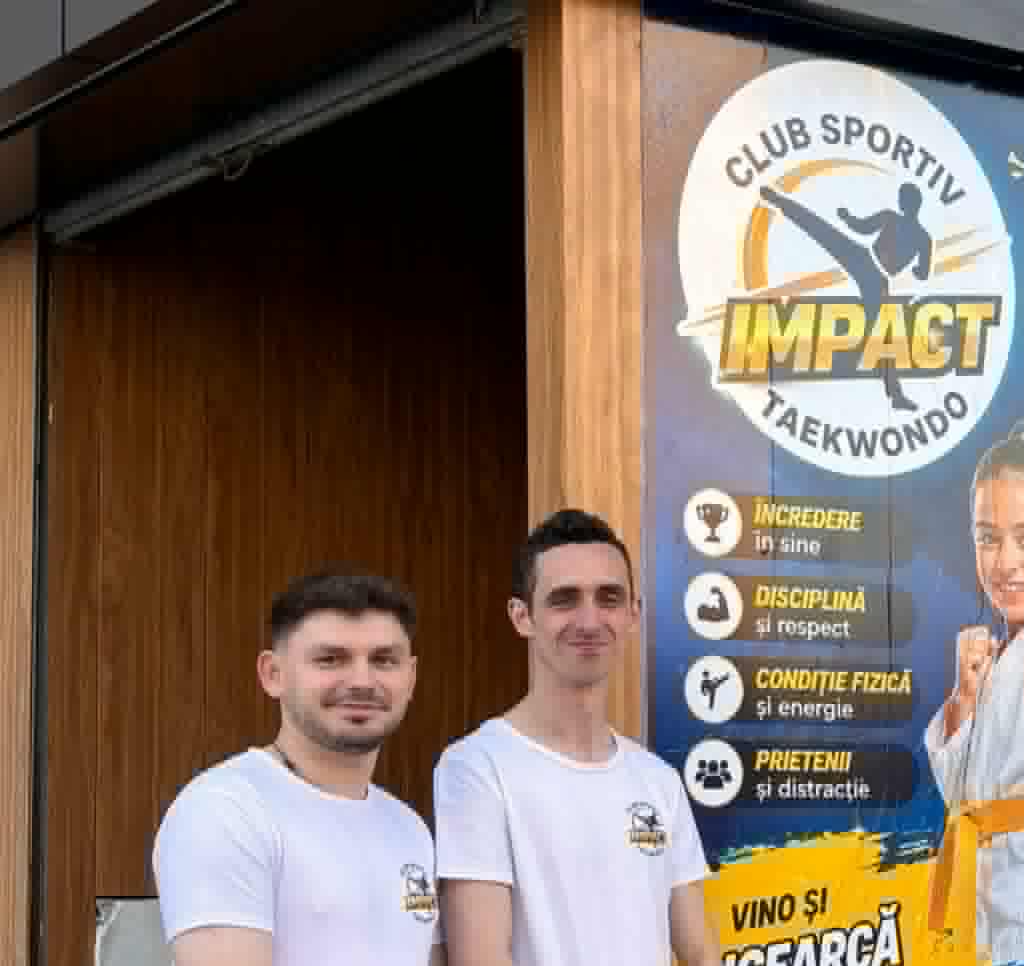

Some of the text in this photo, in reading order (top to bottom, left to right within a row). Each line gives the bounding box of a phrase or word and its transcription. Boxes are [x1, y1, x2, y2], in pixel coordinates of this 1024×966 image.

[726, 114, 967, 206] CLUB SPORTIV
[720, 297, 1001, 383] IMPACT
[761, 390, 969, 458] TAEKWONDO
[754, 497, 864, 530] ÎNCREDERE
[781, 534, 822, 555] sine
[754, 585, 865, 612] DISCIPLINĂ
[777, 618, 851, 641] respect
[755, 668, 912, 695] CONDIȚIE FIZICĂ
[779, 700, 855, 722] energie
[755, 750, 853, 772] PRIETENII
[778, 778, 873, 803] distracție
[731, 887, 828, 933] VINO ȘI
